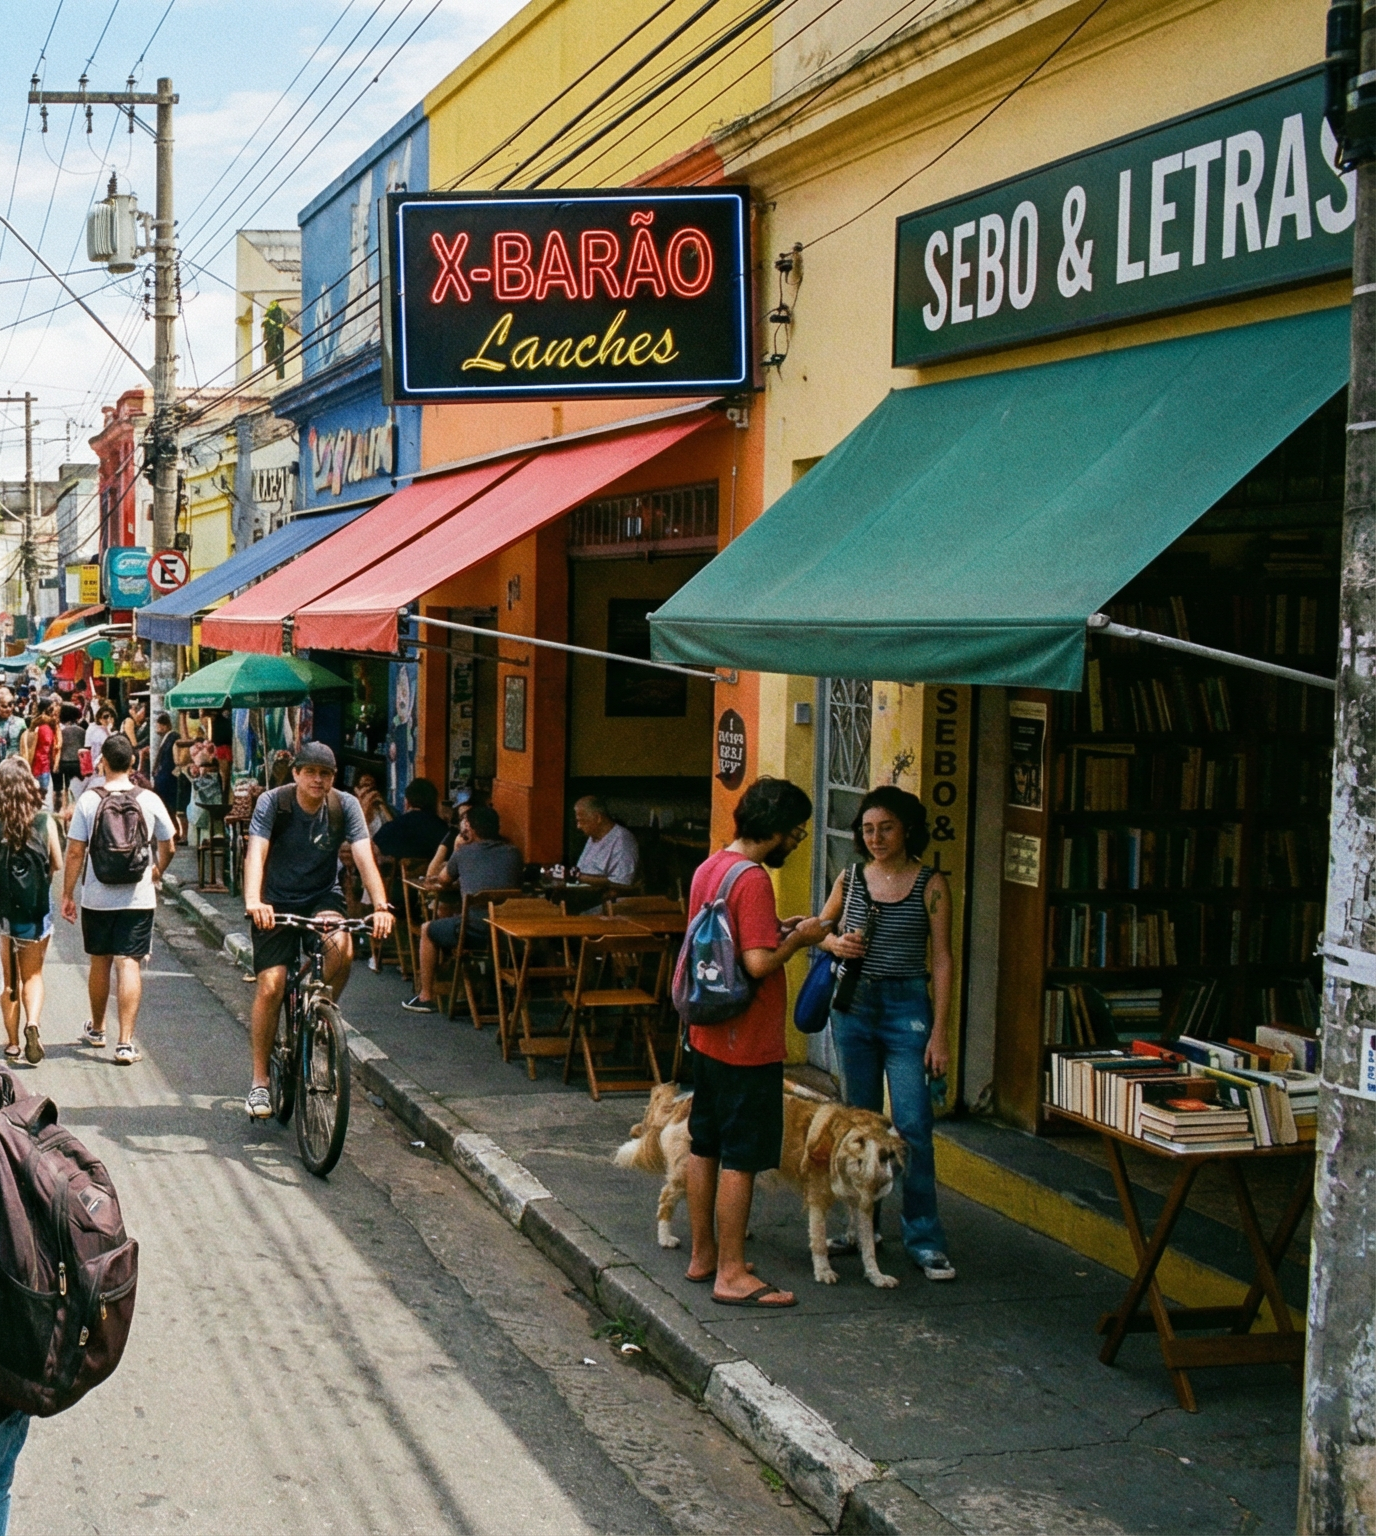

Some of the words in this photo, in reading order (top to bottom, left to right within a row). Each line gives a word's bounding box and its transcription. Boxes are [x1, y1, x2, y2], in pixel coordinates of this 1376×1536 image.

[430, 210, 714, 304] X-BARÃO
[922, 200, 1039, 332] SEBO
[1056, 185, 1094, 299] &
[461, 309, 680, 373] Lanches
[160, 558, 179, 584] E
[932, 688, 958, 807] SEBO
[931, 815, 956, 842] &
